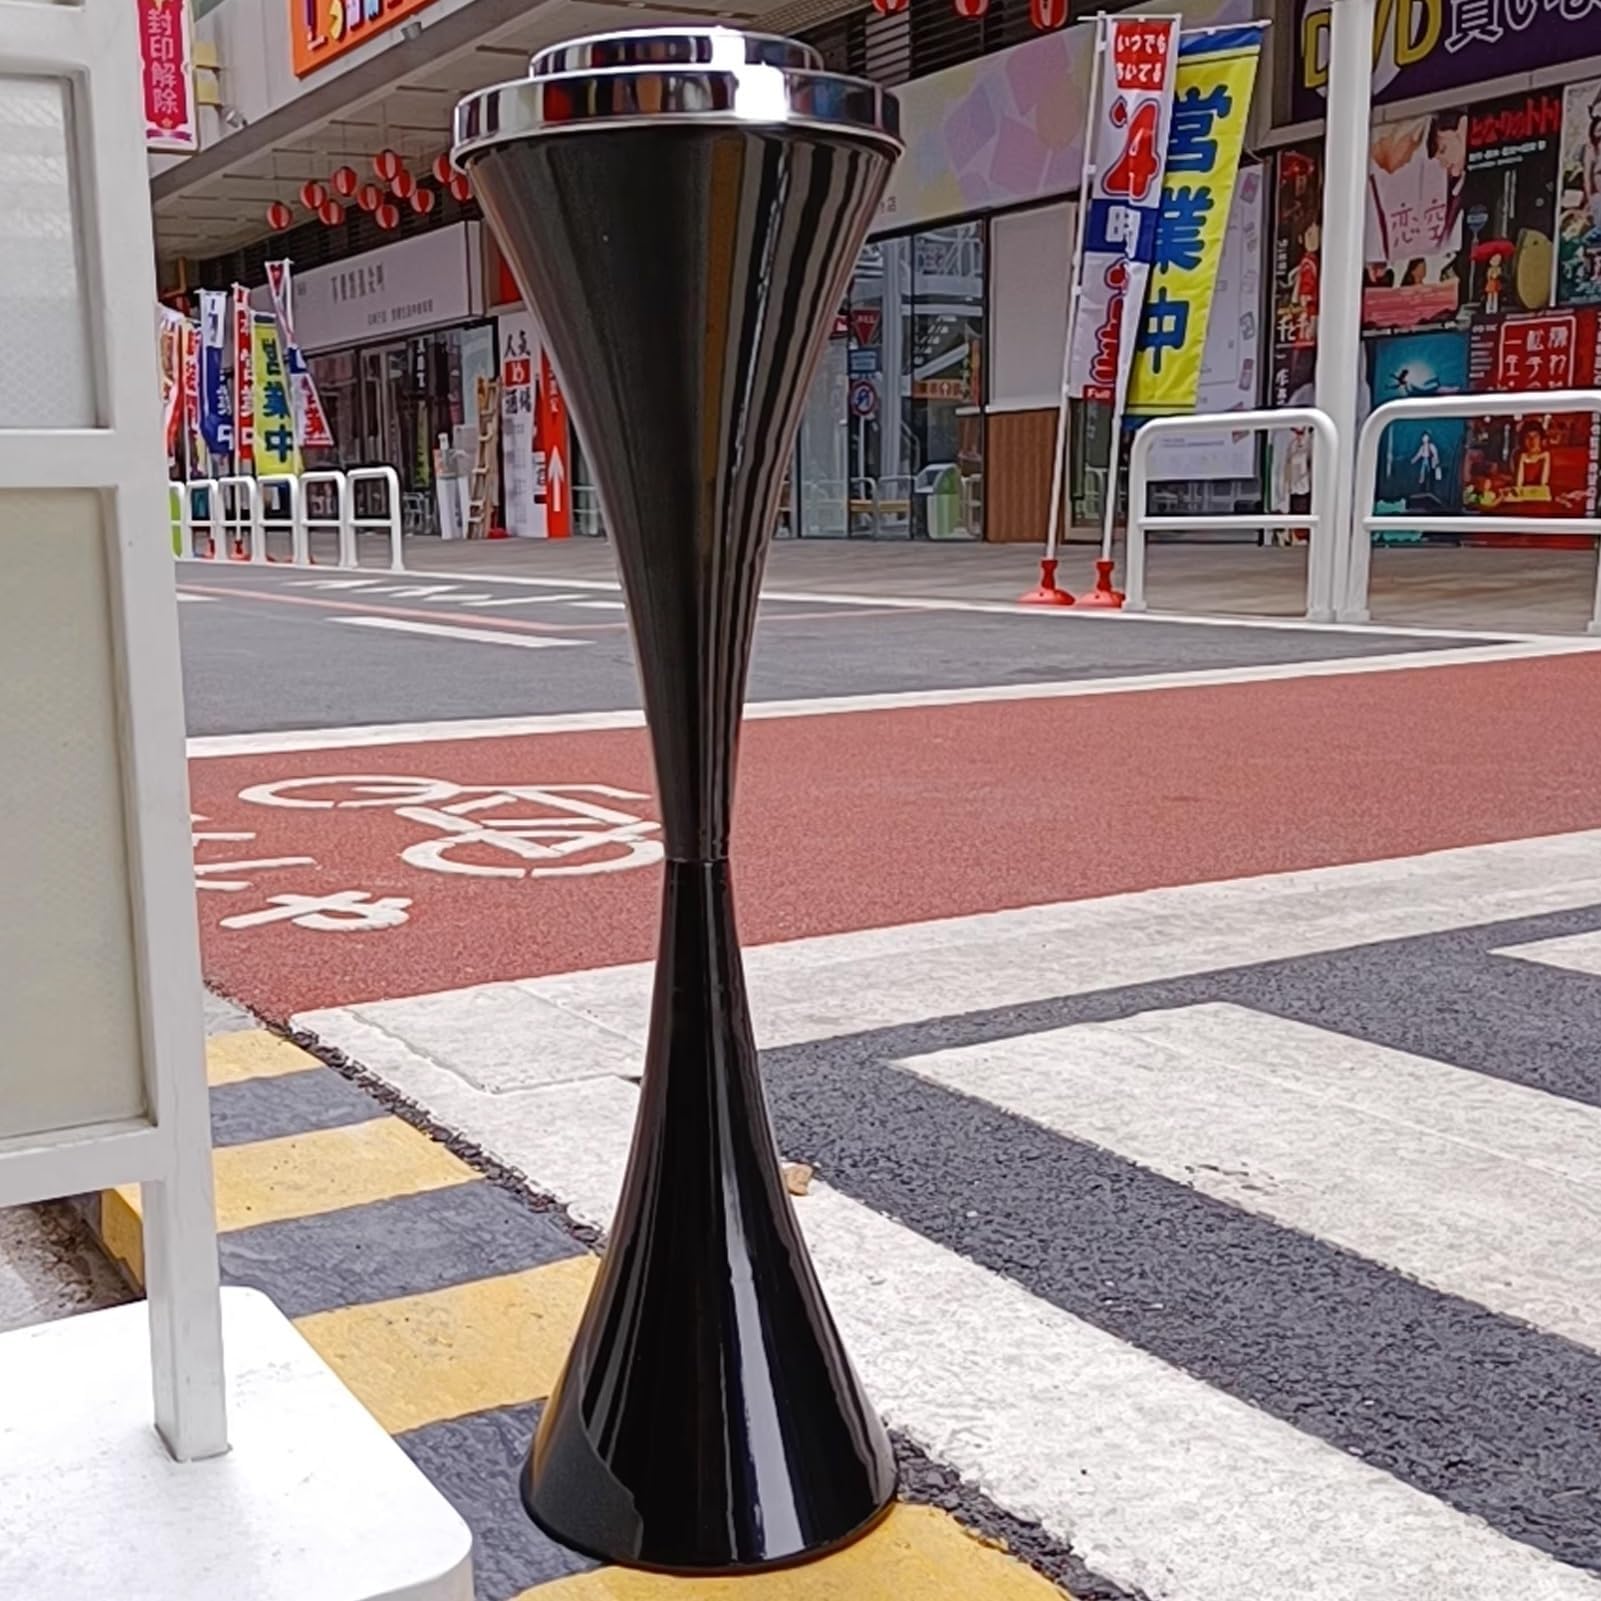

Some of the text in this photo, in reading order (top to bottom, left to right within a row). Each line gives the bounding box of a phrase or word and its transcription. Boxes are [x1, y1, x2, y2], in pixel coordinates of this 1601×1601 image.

[147, 8, 178, 114] 封印解除
[1116, 32, 1167, 54] いつでも
[1140, 84, 1233, 374] 営業中
